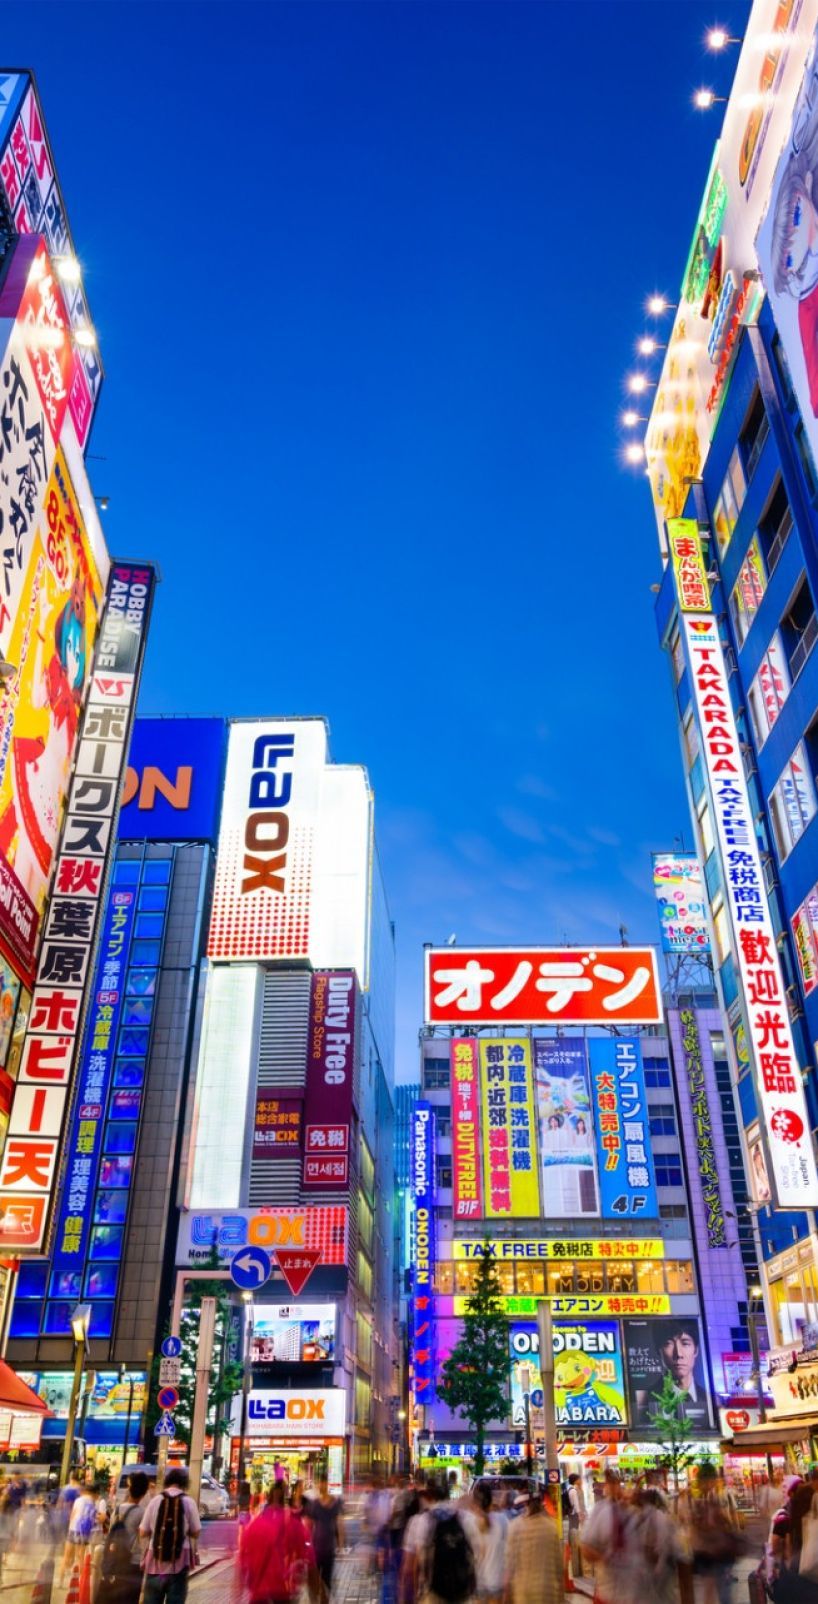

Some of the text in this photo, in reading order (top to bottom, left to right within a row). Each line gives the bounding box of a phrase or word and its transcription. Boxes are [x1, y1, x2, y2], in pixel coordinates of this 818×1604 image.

[674, 537, 708, 608] まんが喫茶
[124, 570, 149, 634] HOBBY
[98, 568, 130, 667] PARADISE
[693, 648, 738, 773] TAKARADA
[726, 851, 765, 922] 免税商店
[115, 894, 130, 904] 6F
[433, 952, 650, 1013] オノデン
[99, 993, 116, 1003] 5F
[313, 977, 326, 1059] Flagship Store
[738, 927, 798, 1094] 歓迎光臨
[324, 976, 353, 1085] Duty Free
[454, 1044, 474, 1081] 免税
[81, 1106, 100, 1117] 4F
[309, 1129, 344, 1147] 免税
[415, 1110, 429, 1196] Panasonic
[307, 1163, 344, 1176] 면세점
[457, 1200, 478, 1215] B1F
[612, 1195, 646, 1213] 4F
[188, 1249, 211, 1258] Hom
[416, 1208, 430, 1284] ONODEN
[462, 1243, 496, 1257] TAX
[502, 1243, 548, 1257] FREE
[552, 1242, 593, 1257] 免税店
[284, 1258, 312, 1269] 止まれ
[560, 1278, 634, 1292] MODFY
[553, 1299, 603, 1312] エアコン
[608, 1299, 662, 1312] 特売中!!
[557, 1431, 590, 1442] ルーレイ
